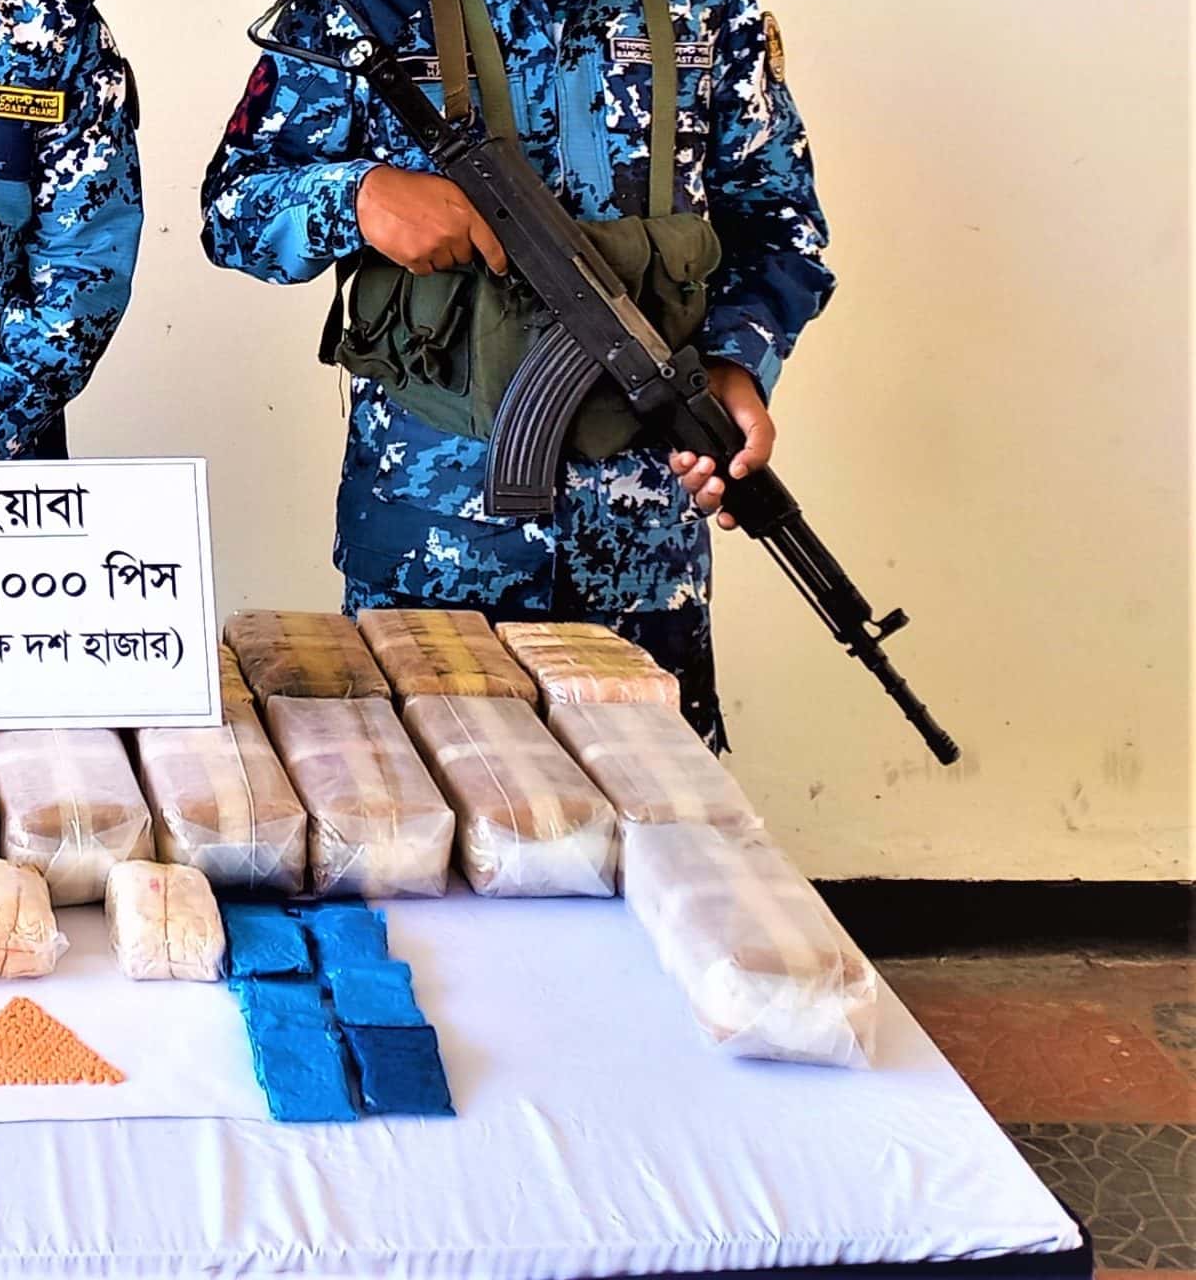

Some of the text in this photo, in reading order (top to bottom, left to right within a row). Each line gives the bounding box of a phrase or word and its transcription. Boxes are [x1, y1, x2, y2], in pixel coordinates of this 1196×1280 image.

[101, 550, 182, 600] পিস
[22, 630, 72, 662] দশ
[79, 627, 184, 669] হাজার)
